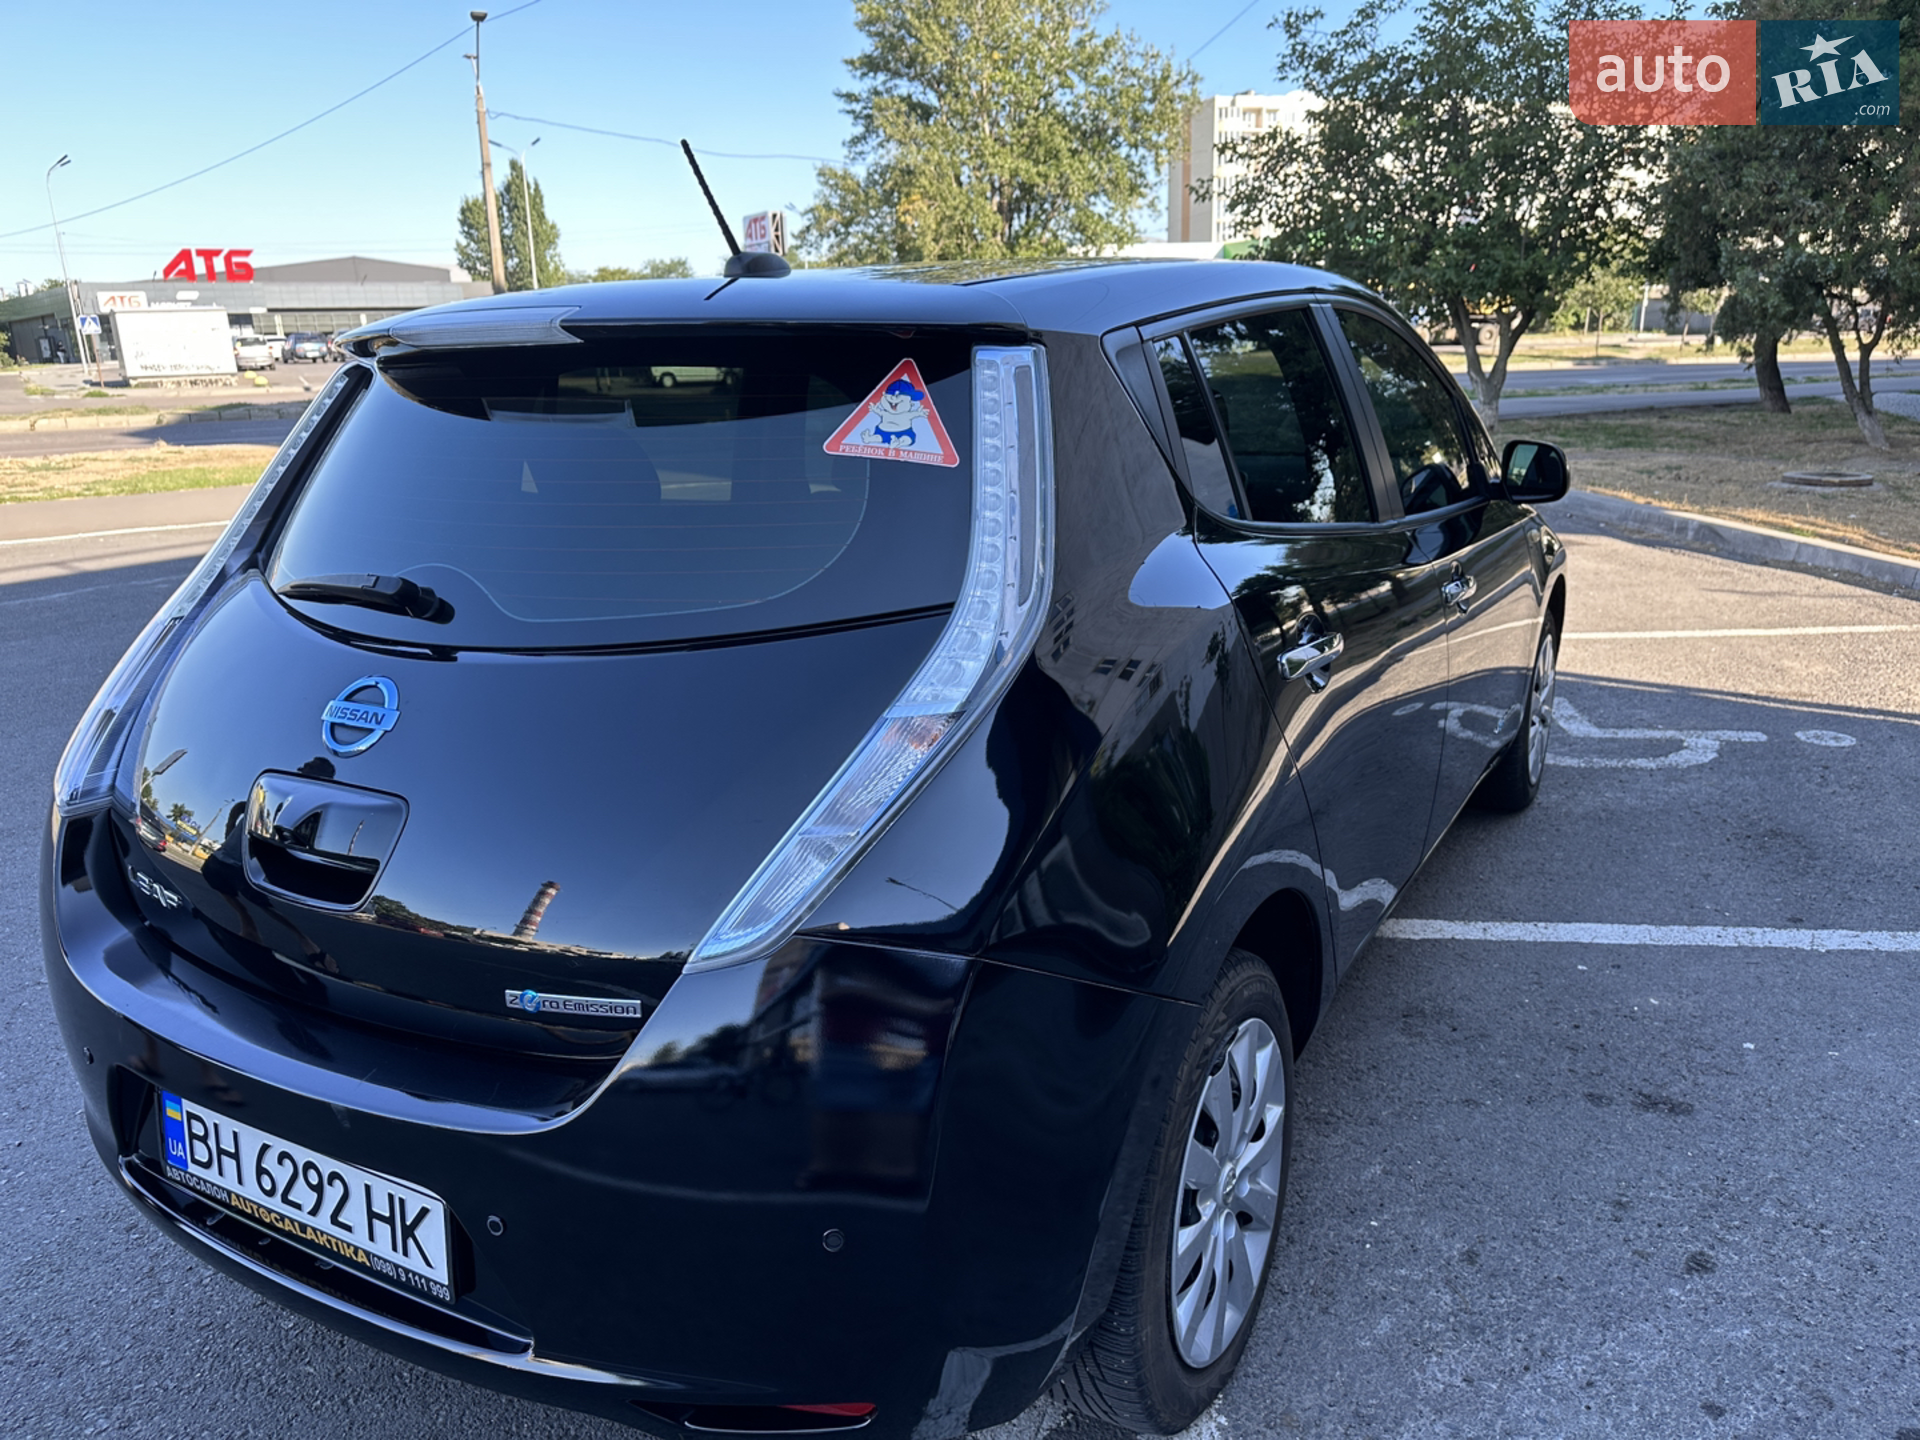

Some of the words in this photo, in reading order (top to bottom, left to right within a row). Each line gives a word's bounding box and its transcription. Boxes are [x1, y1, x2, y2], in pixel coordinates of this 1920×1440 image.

[888, 449, 896, 457] В
[899, 450, 944, 463] МАШИНЕ
[325, 704, 386, 725] NISSAN
[168, 1137, 186, 1160] UA
[185, 1109, 243, 1186] BH
[255, 1141, 355, 1234] 6292
[363, 1179, 435, 1269] HK
[166, 1166, 230, 1203] АВТОСАЛОН
[231, 1193, 371, 1266] AUTOGALAKTIKA
[371, 1253, 397, 1279] (098)
[398, 1267, 406, 1282] 9
[408, 1272, 427, 1291] 111
[429, 1282, 451, 1301] 999
